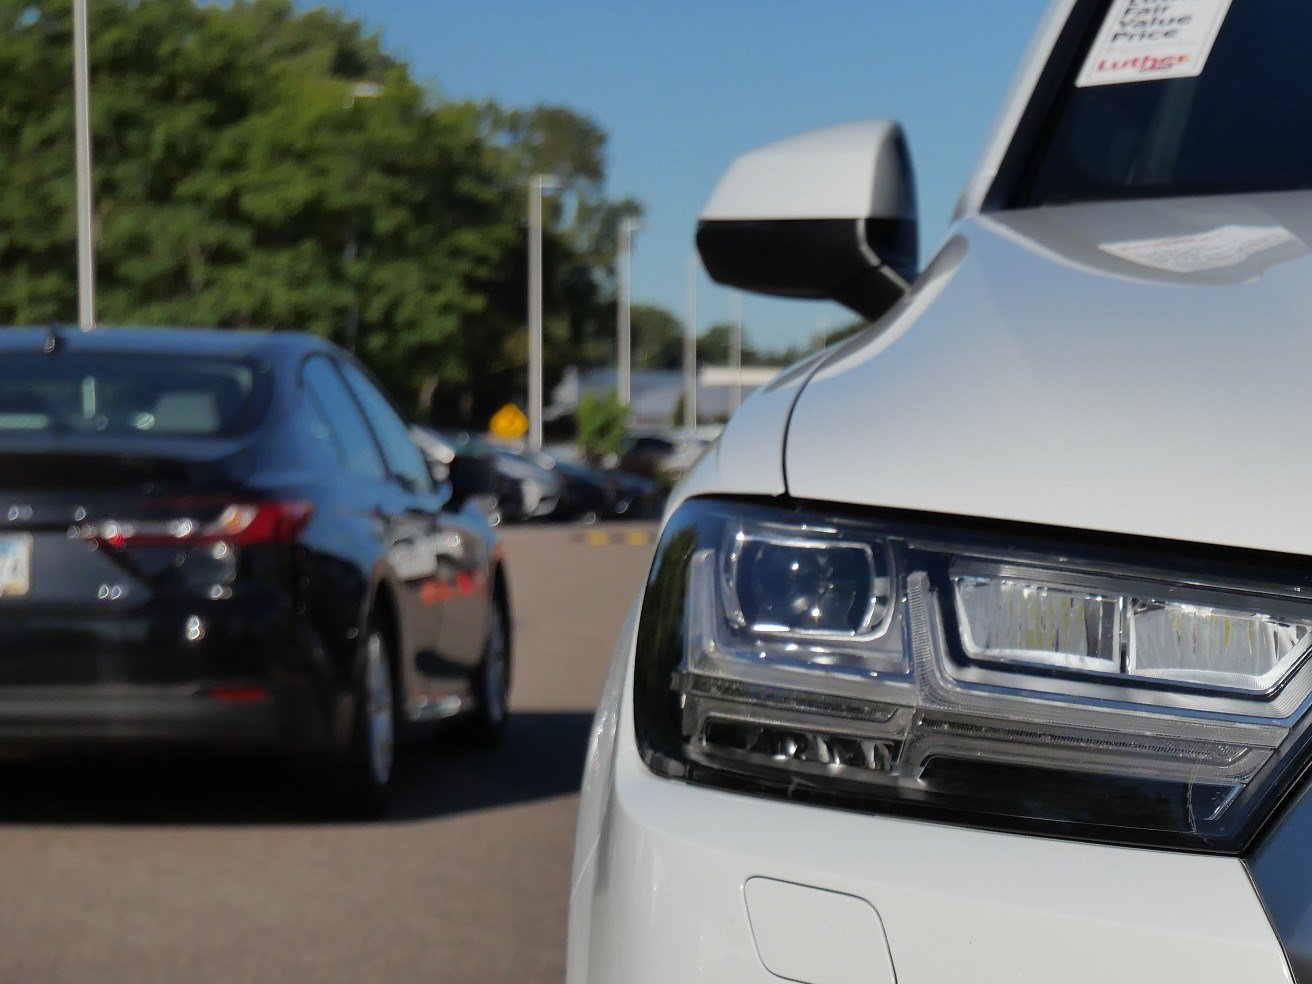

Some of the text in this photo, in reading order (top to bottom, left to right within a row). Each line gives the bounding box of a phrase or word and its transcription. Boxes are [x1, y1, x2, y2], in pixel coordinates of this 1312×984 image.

[1119, 14, 1192, 28] Value
[1111, 28, 1179, 42] Price
[1095, 54, 1192, 73] Luther
